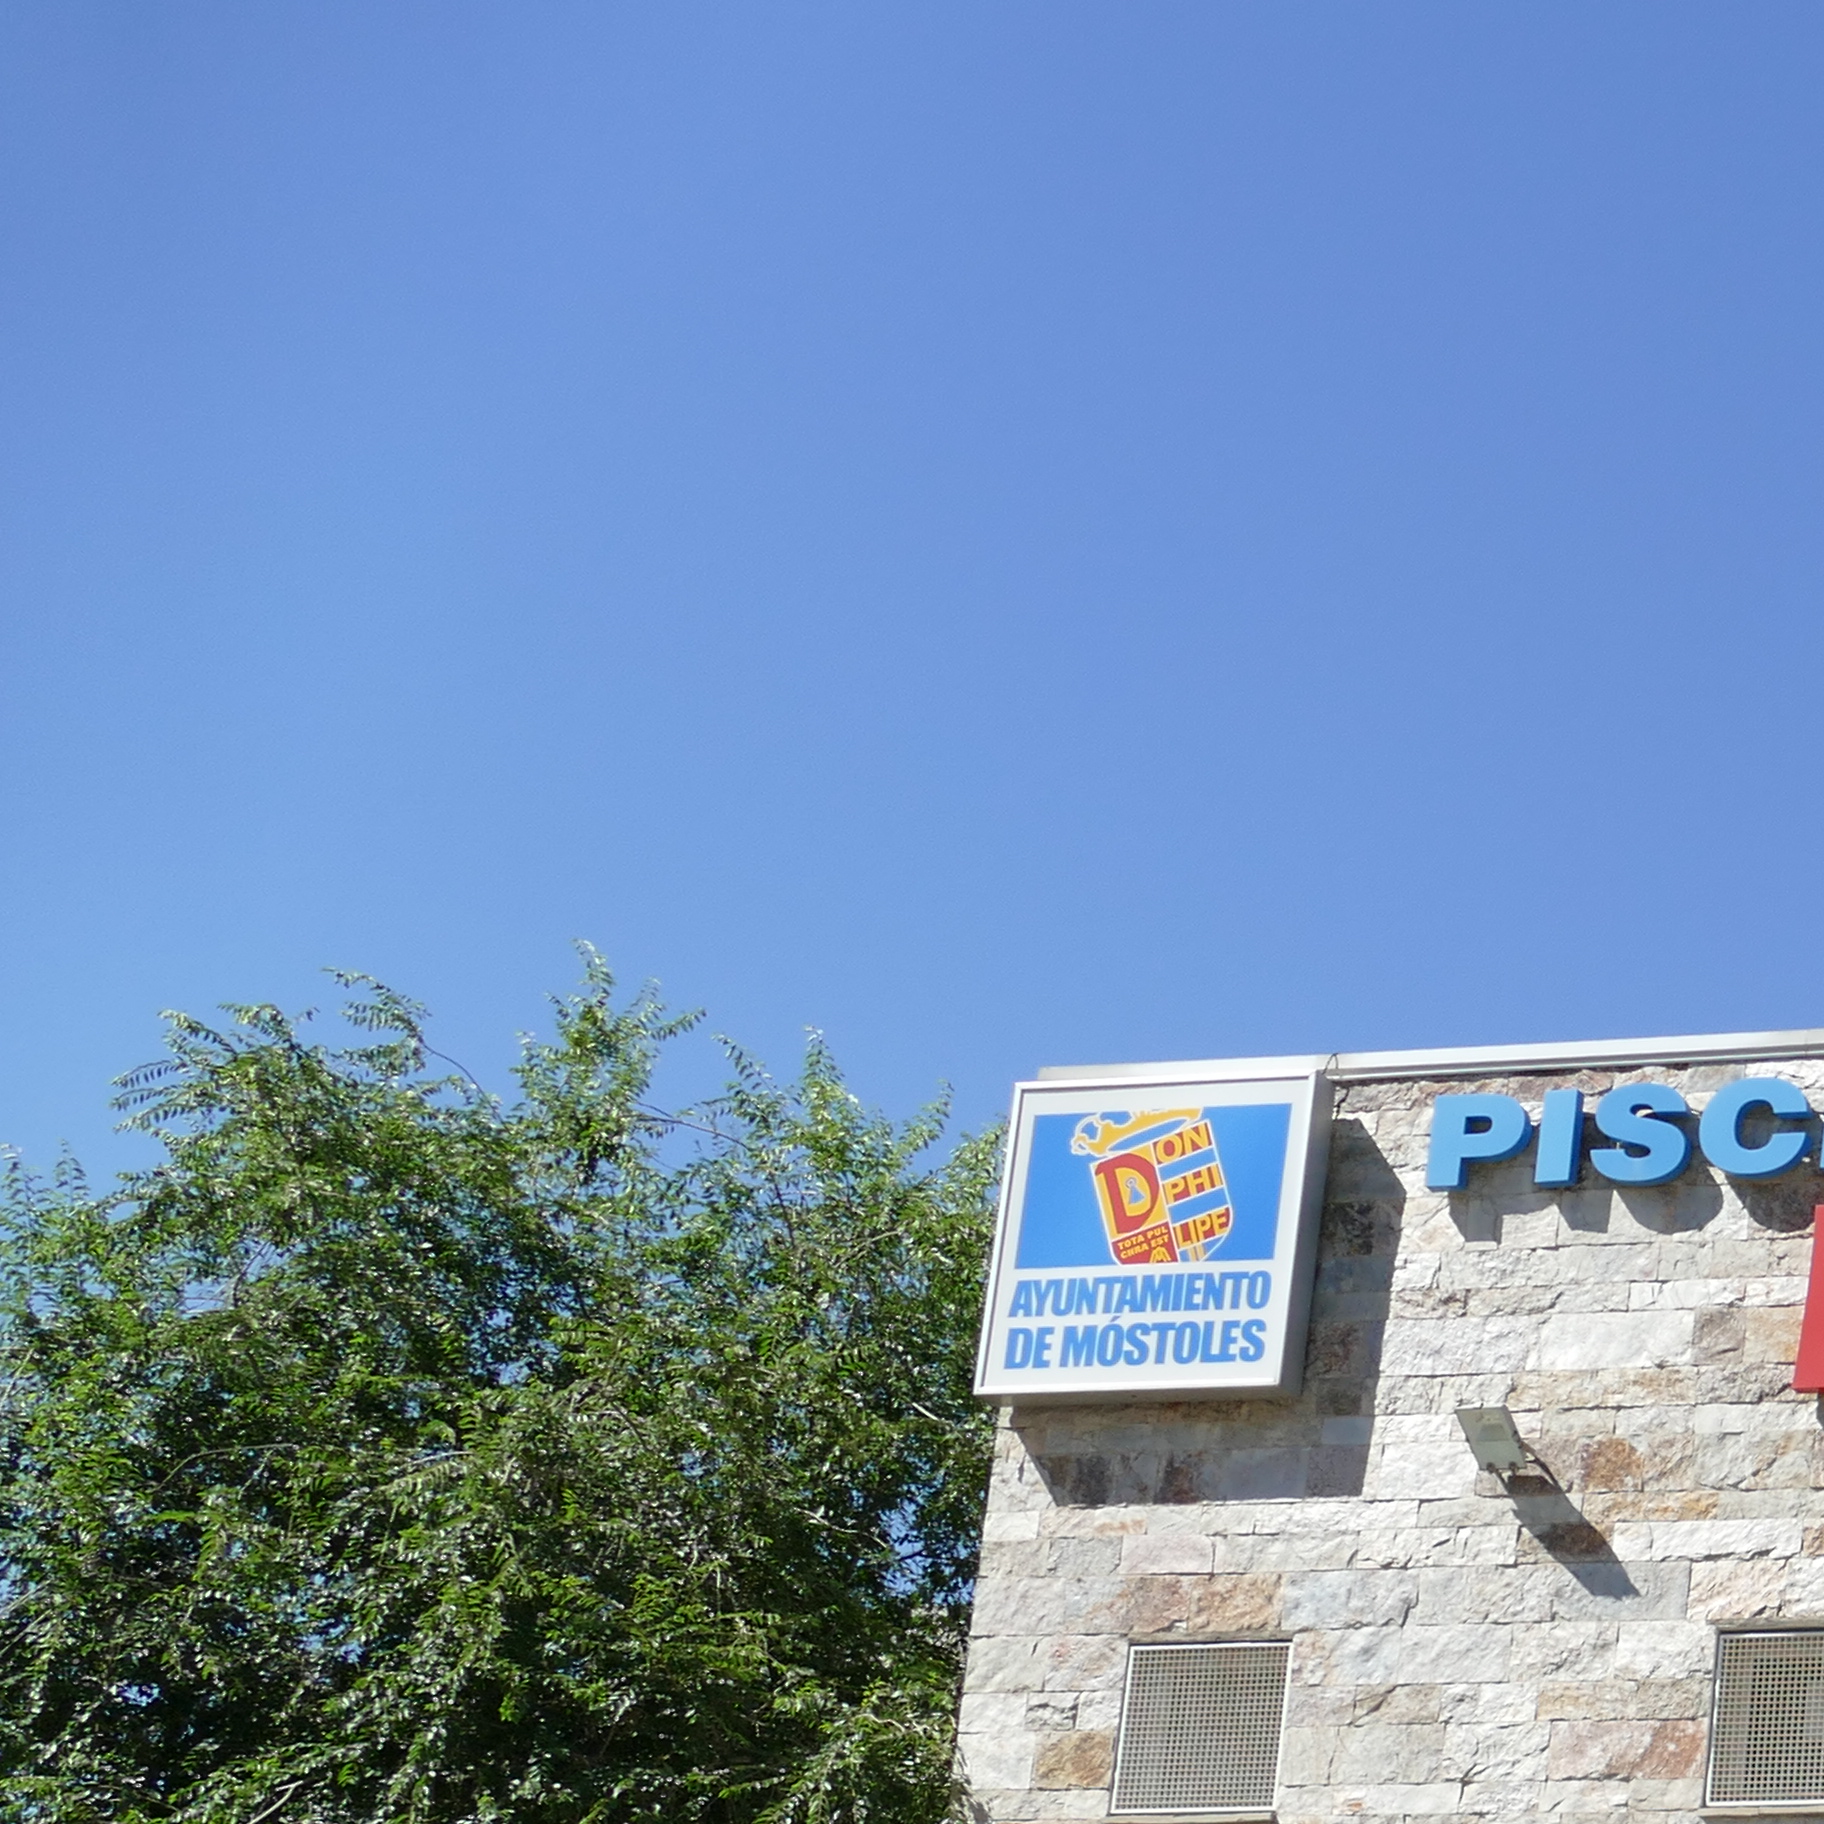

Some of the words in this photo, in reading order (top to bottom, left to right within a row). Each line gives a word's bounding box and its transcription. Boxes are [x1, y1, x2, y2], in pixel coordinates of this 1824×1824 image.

[1117, 1234, 1145, 1250] TOTA
[1146, 1226, 1169, 1239] PUL
[1150, 1233, 1169, 1248] EST
[1007, 1270, 1272, 1318] AYUNTAMIENTO
[1003, 1325, 1055, 1370] DE
[1059, 1316, 1267, 1368] MÓSTOLES
